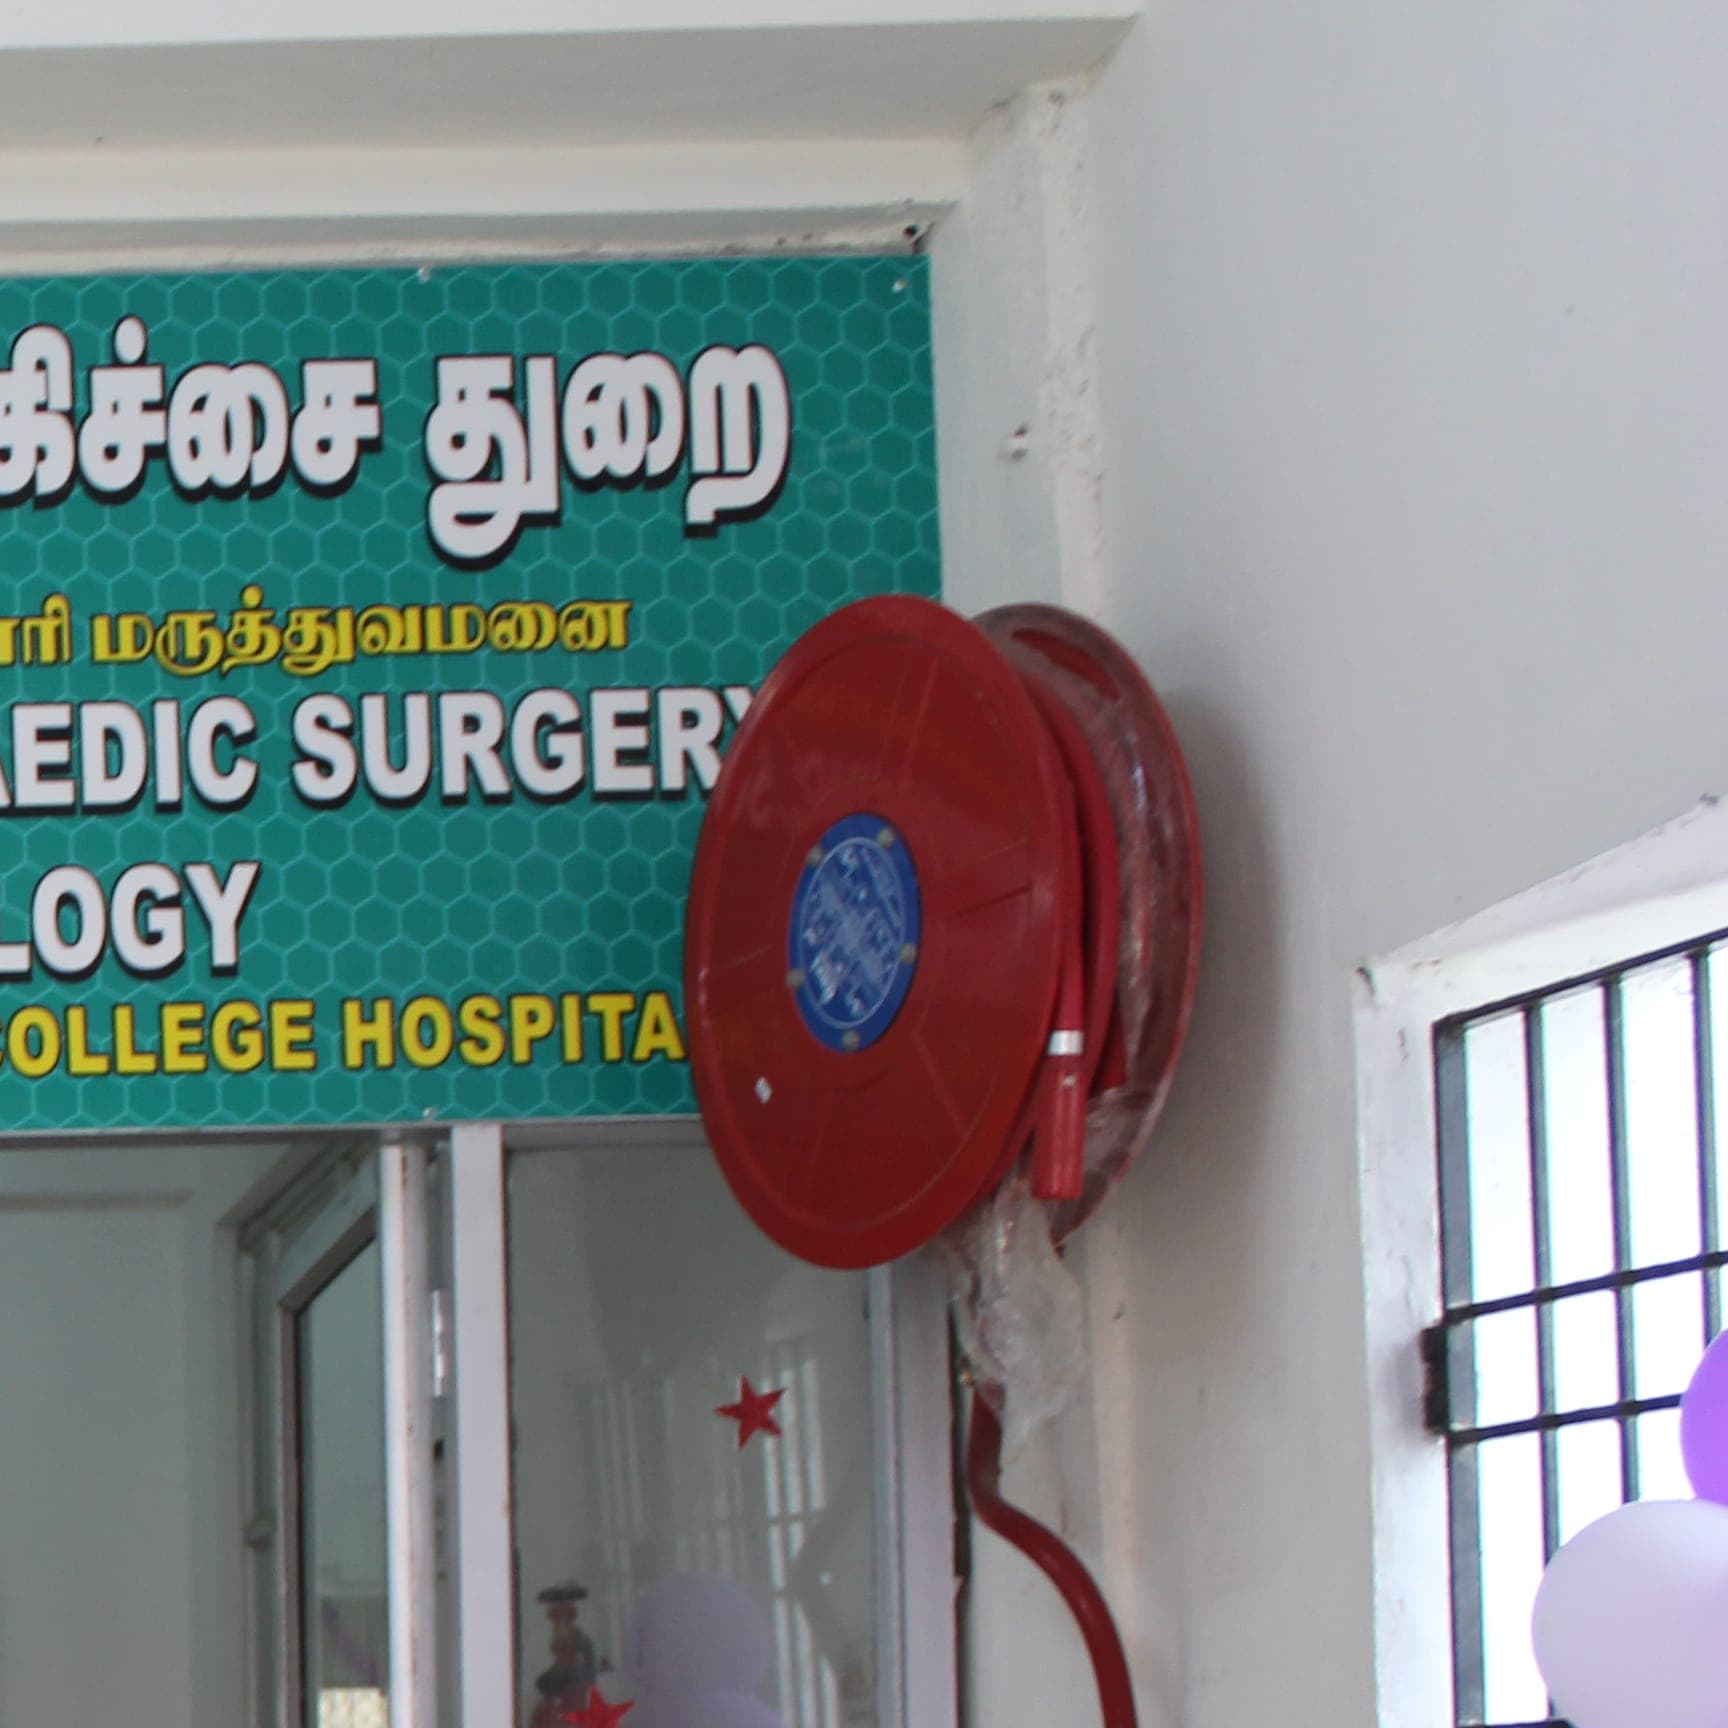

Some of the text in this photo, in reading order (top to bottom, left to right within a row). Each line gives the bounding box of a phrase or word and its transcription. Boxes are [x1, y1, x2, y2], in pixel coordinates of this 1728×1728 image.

[426, 342, 790, 570] துறை
[92, 585, 633, 677] மருத்துவமனை
[292, 685, 754, 809] SURGER
[341, 991, 687, 1072] HOSPITA
